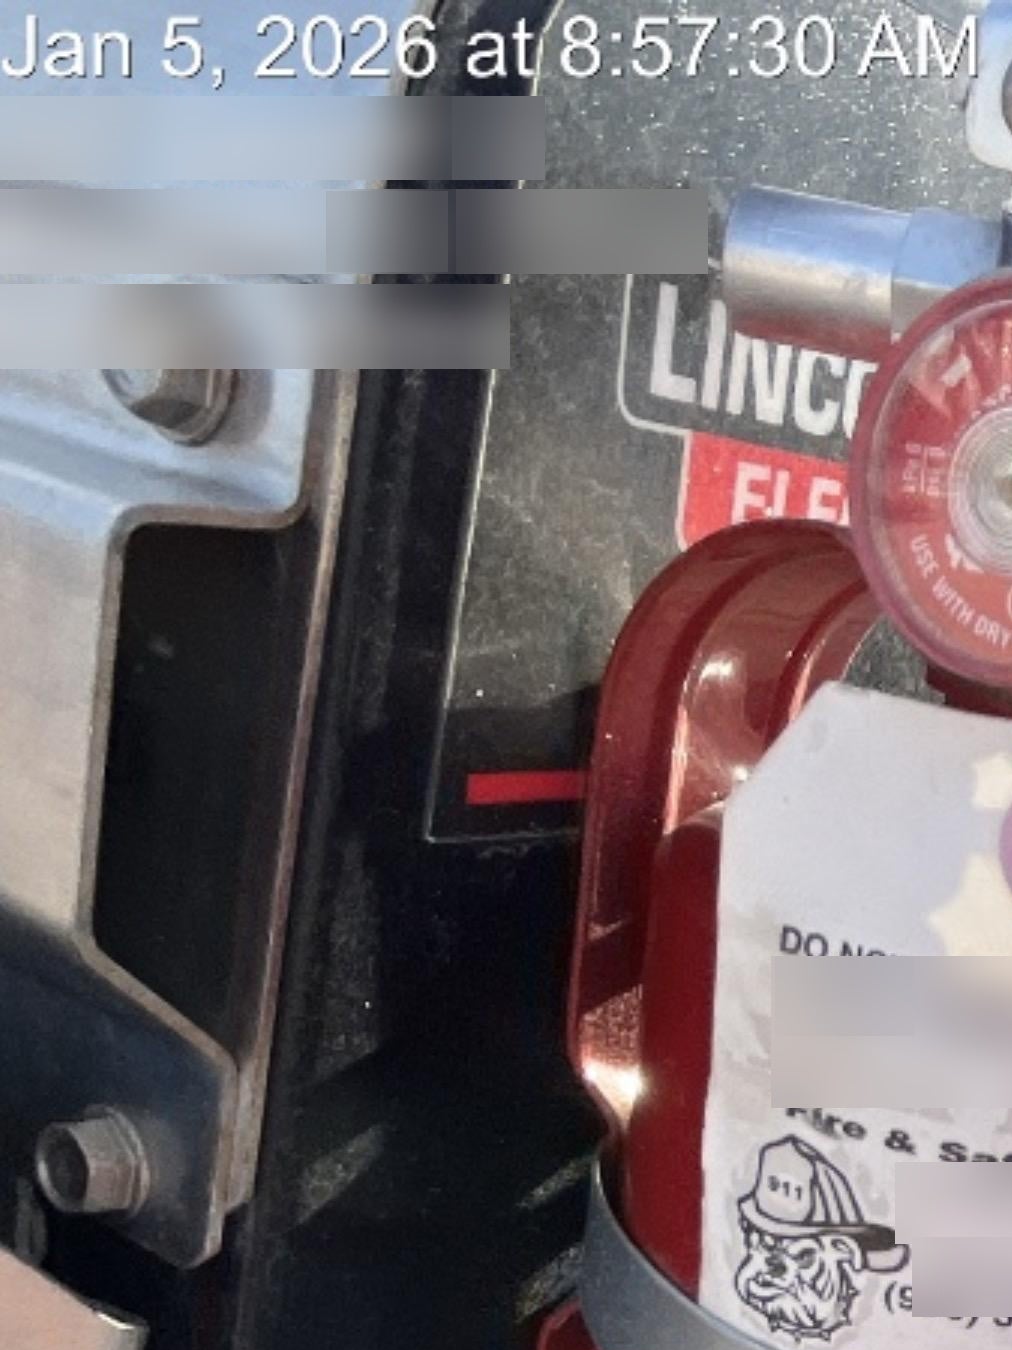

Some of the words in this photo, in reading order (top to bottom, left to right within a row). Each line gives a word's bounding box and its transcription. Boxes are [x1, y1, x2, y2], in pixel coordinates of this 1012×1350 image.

[911, 533, 940, 580] USE
[932, 575, 977, 627] WITH
[973, 614, 1012, 650] DRY
[779, 924, 829, 957] DO
[884, 1129, 917, 1156] &
[766, 1175, 804, 1202] 911
